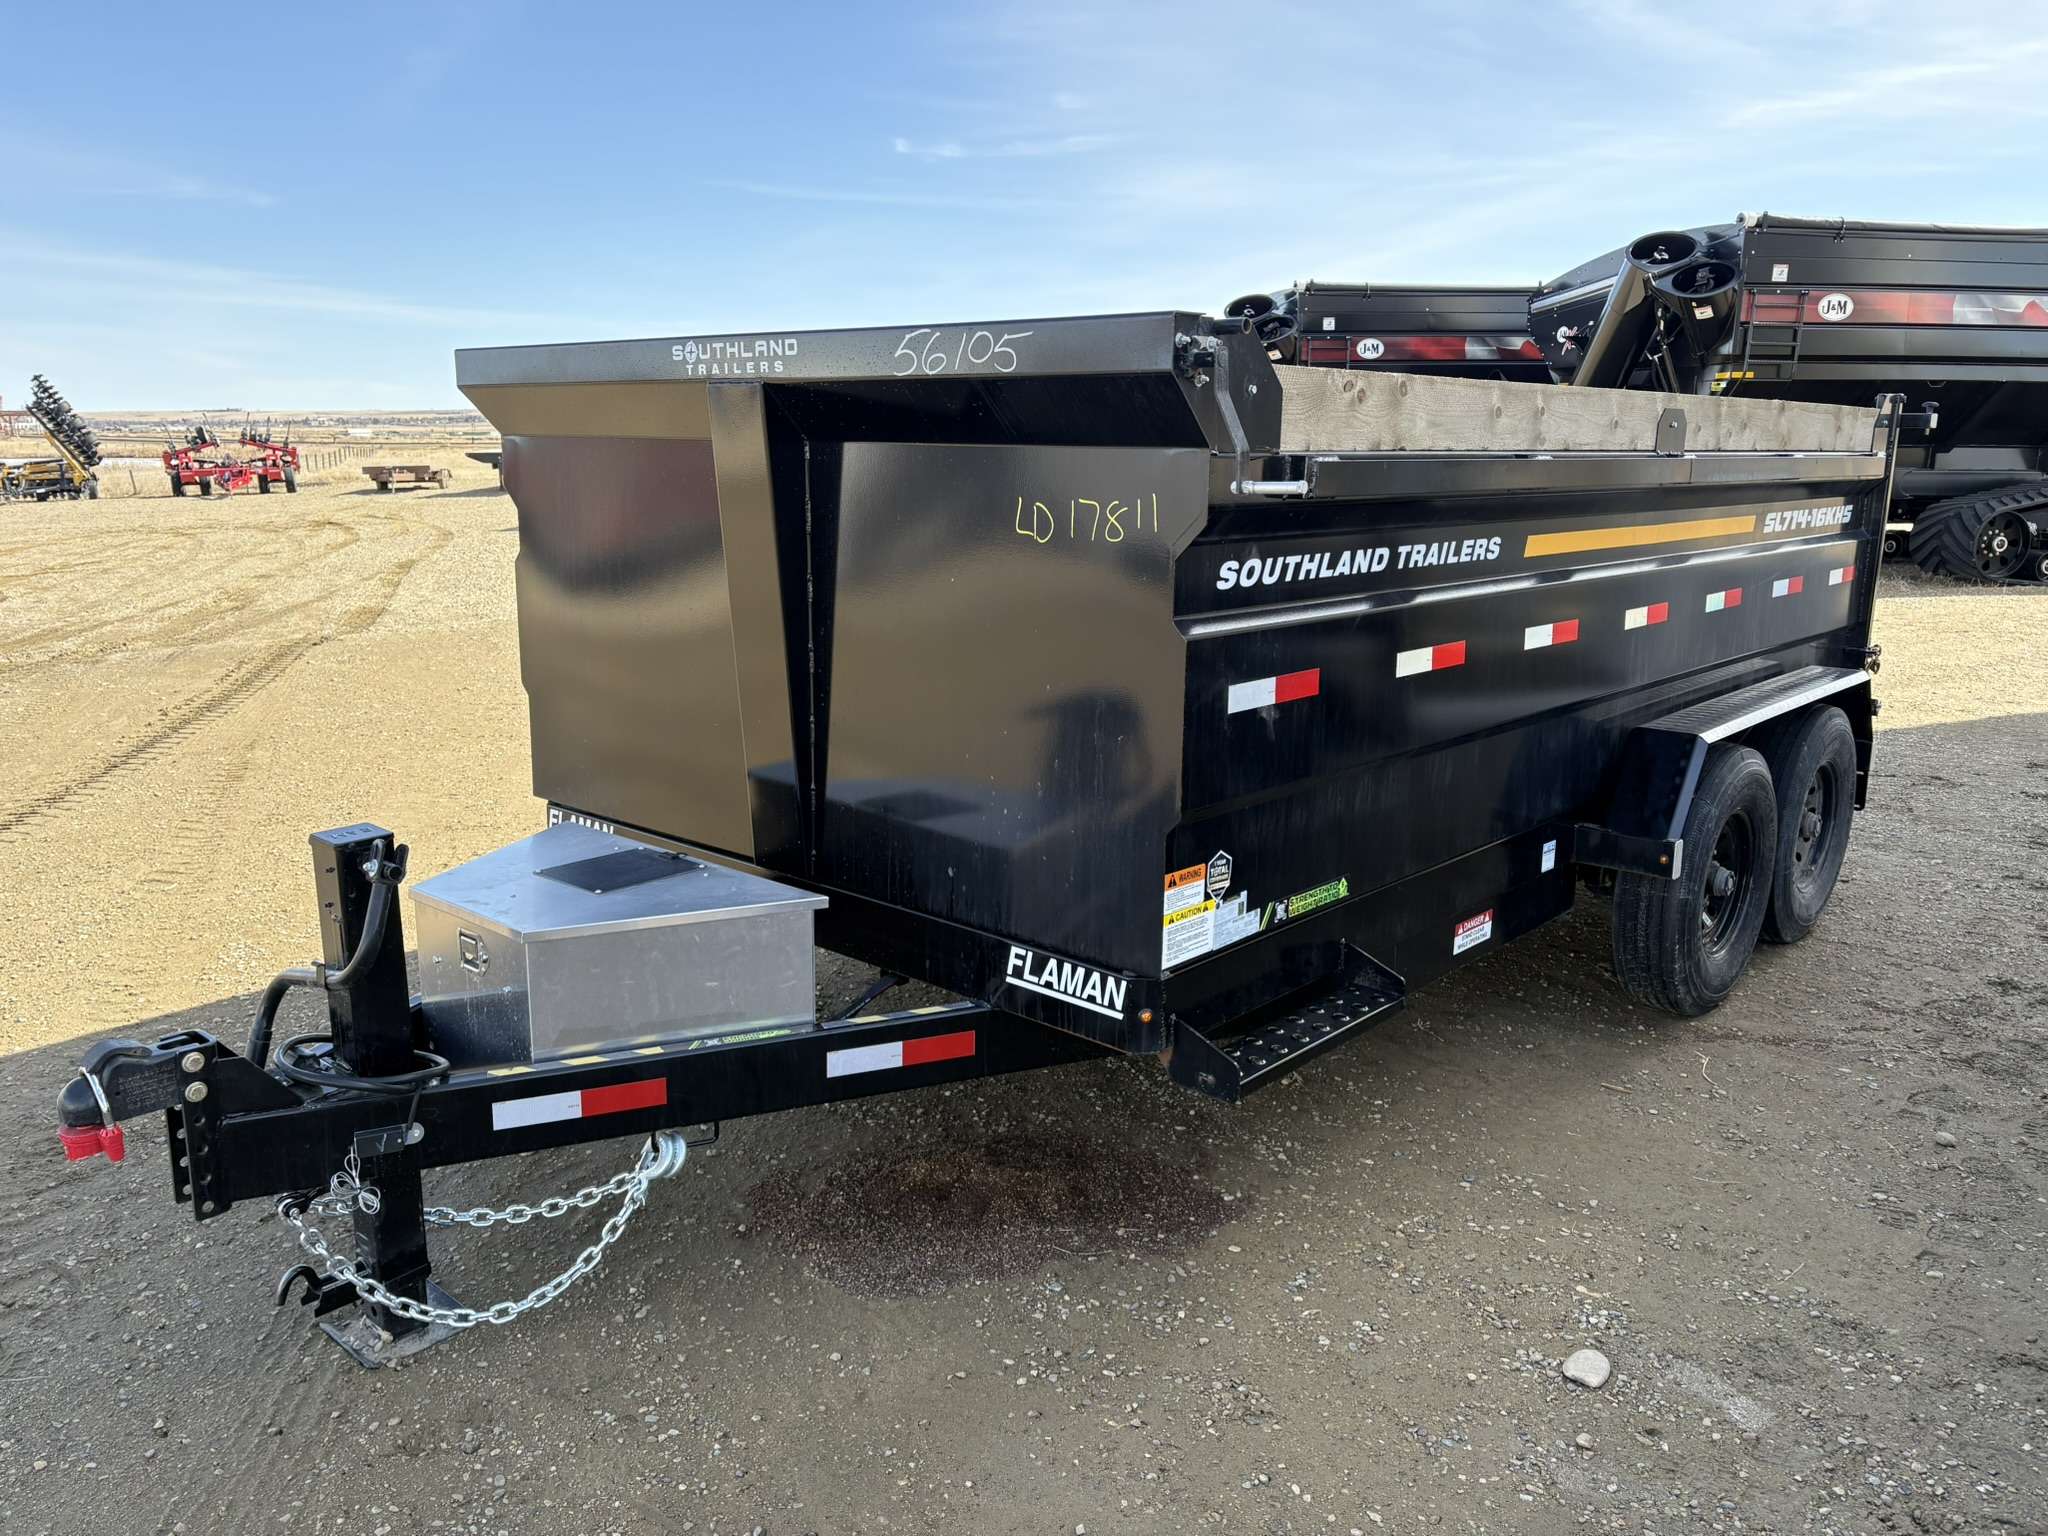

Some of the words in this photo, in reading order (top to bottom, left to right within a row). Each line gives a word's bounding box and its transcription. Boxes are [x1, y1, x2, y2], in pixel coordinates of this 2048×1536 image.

[1822, 299, 1848, 315] J&M
[672, 339, 798, 363] SOUTHLAND
[894, 328, 1034, 376] 56105
[1360, 343, 1380, 355] J&M
[685, 360, 784, 376] TRAILERS
[1070, 493, 1158, 543] 17811
[1216, 547, 1390, 590] SOUTHLAND
[1397, 536, 1502, 569] TRAILERS
[1179, 868, 1202, 882] WARNING
[1175, 905, 1202, 921] CAUTION
[1463, 914, 1485, 931] DANGER
[1006, 945, 1128, 1011] FLAMAN
